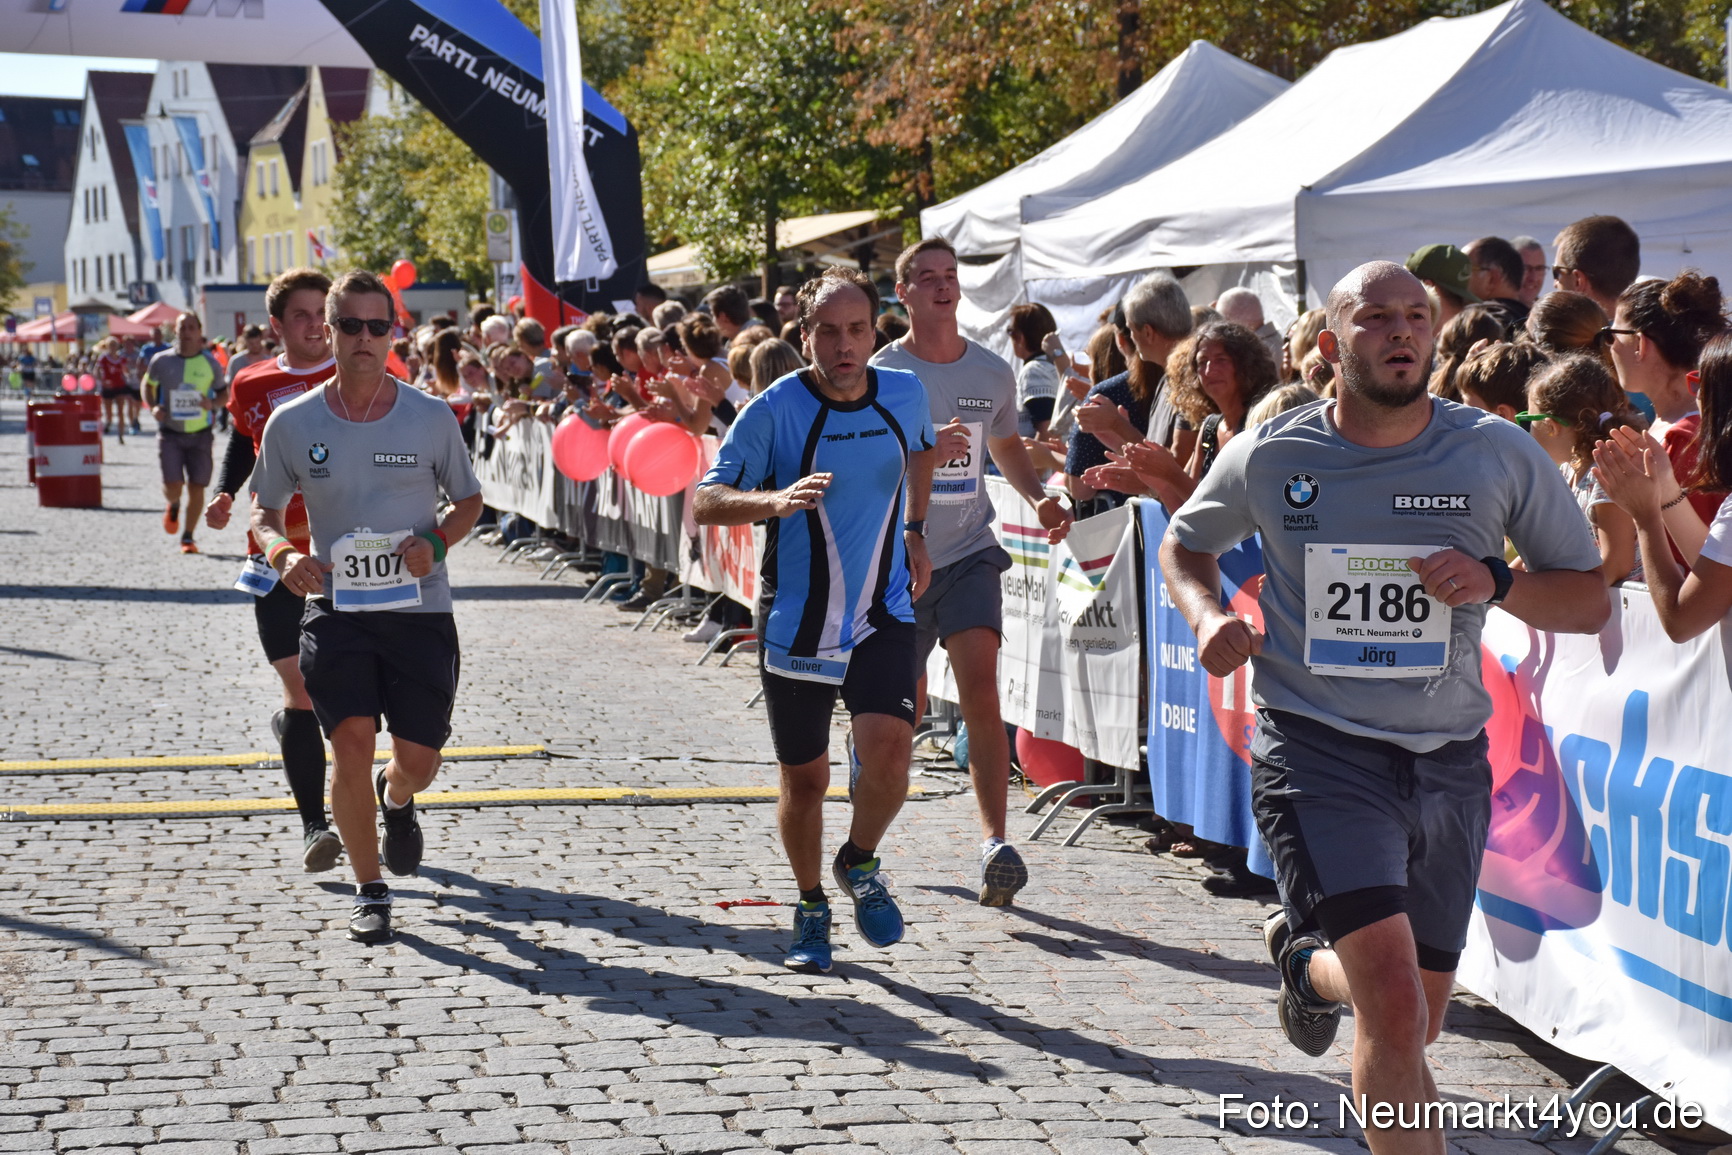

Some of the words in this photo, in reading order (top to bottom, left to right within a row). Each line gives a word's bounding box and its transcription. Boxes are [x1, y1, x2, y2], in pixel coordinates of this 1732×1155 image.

[409, 23, 478, 79] PARTL
[581, 212, 610, 263] PARTL
[958, 397, 992, 409] BOCK
[374, 453, 417, 464] BOCK
[932, 481, 965, 492] ernhard
[1393, 495, 1471, 511] BOCK
[1283, 514, 1319, 524] PARTL
[1283, 524, 1319, 532] Neumarkt
[355, 538, 391, 548] BOCK
[344, 553, 404, 578] 3107
[1347, 558, 1411, 572] BOCK
[1327, 582, 1431, 623] 2186
[1336, 627, 1365, 636] PARTL
[1367, 628, 1409, 637] Neumarkt
[1358, 646, 1396, 667] Jörg
[791, 659, 823, 673] Oliver
